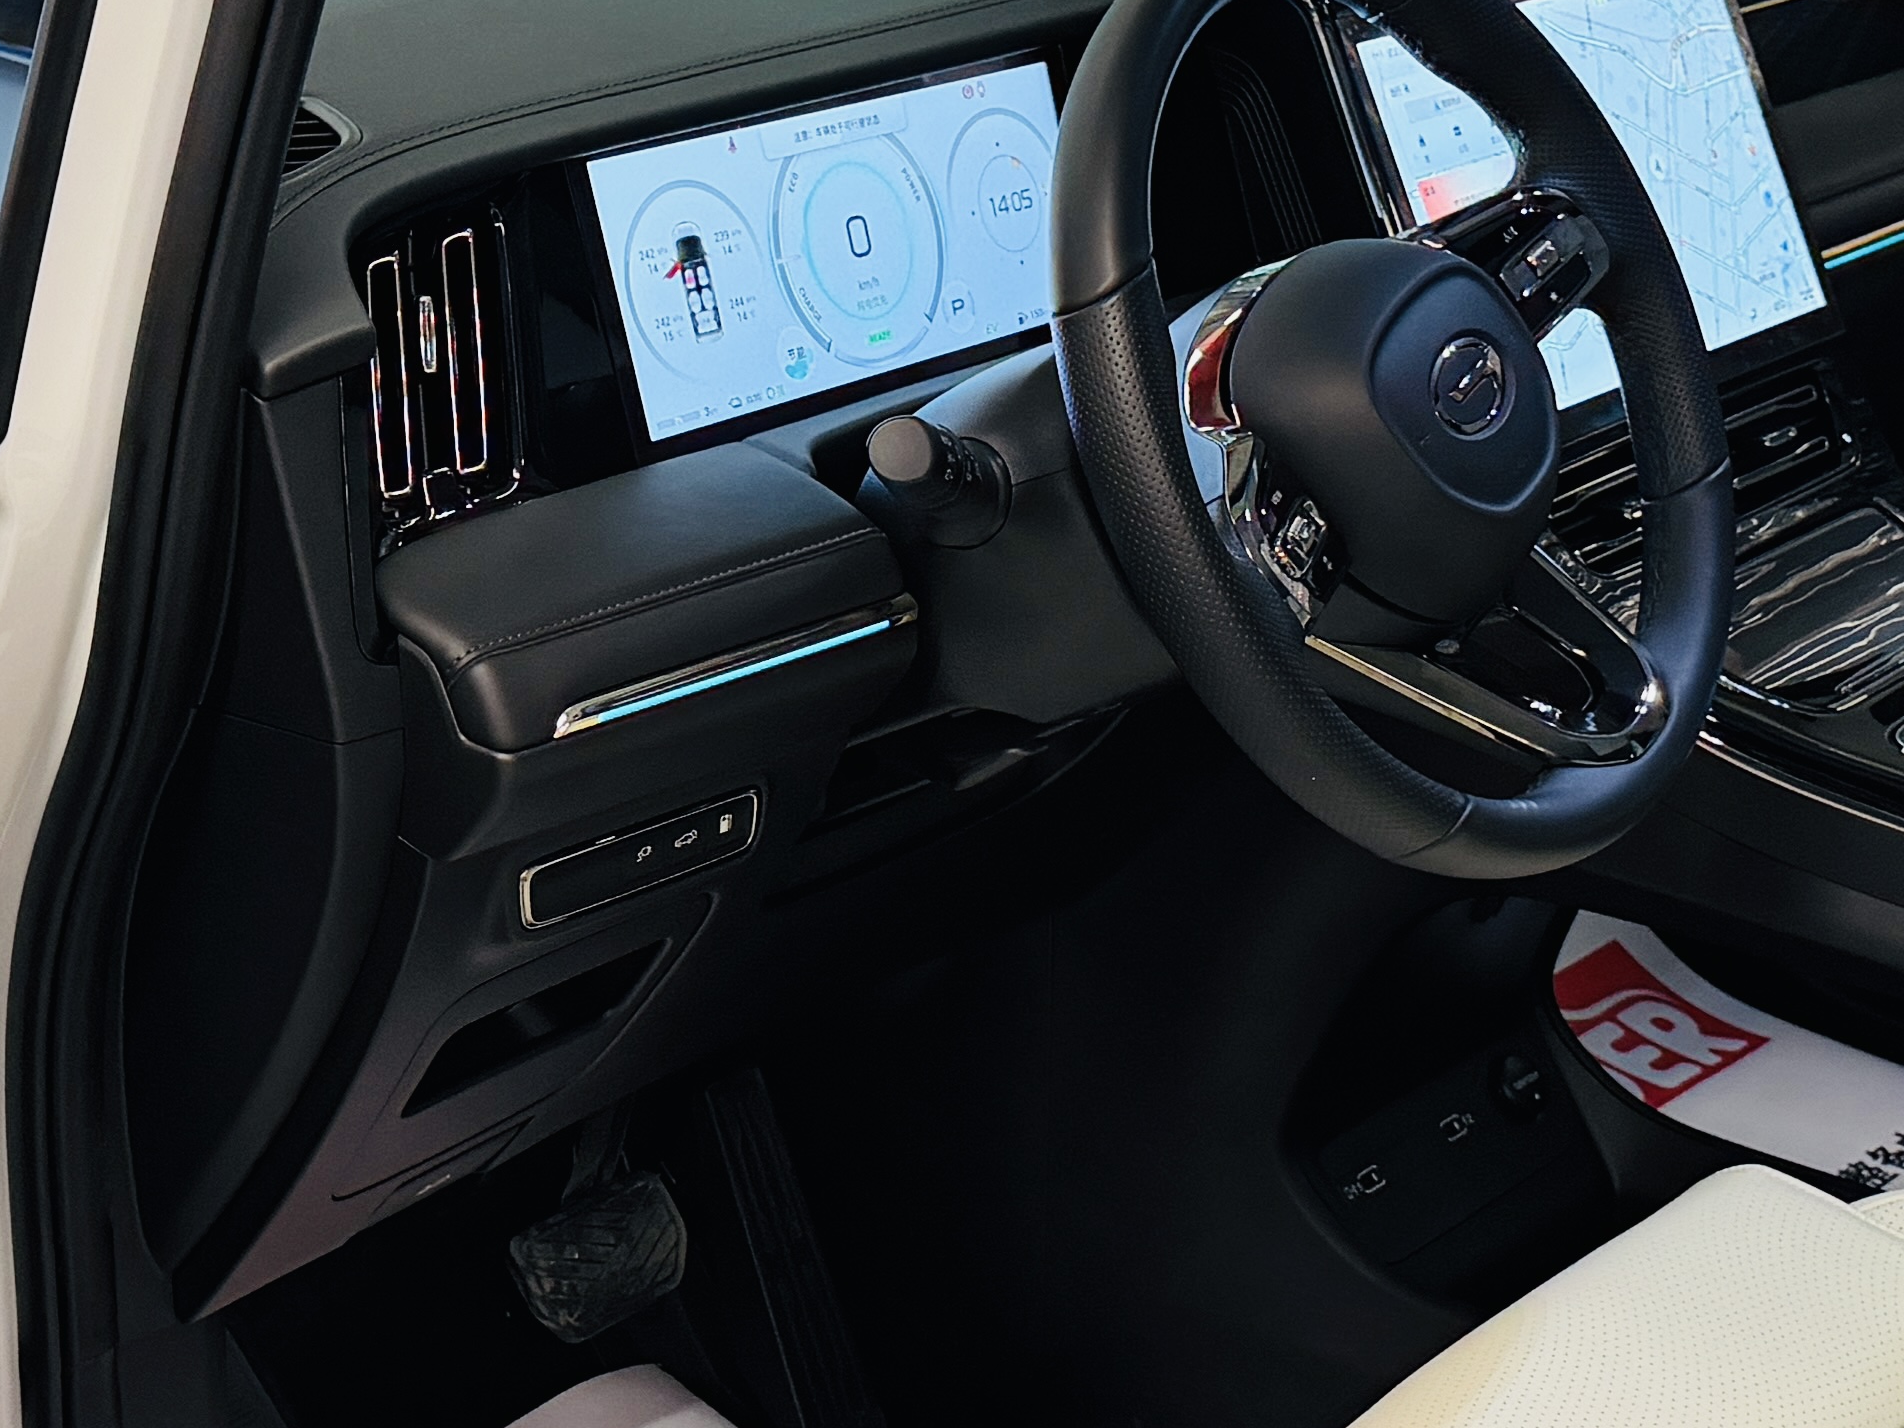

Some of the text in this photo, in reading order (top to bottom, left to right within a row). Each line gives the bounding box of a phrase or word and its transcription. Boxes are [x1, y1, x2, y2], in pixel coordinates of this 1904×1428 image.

[845, 214, 872, 259] 0
[951, 298, 965, 315] P
[1578, 999, 1748, 1102] ER
